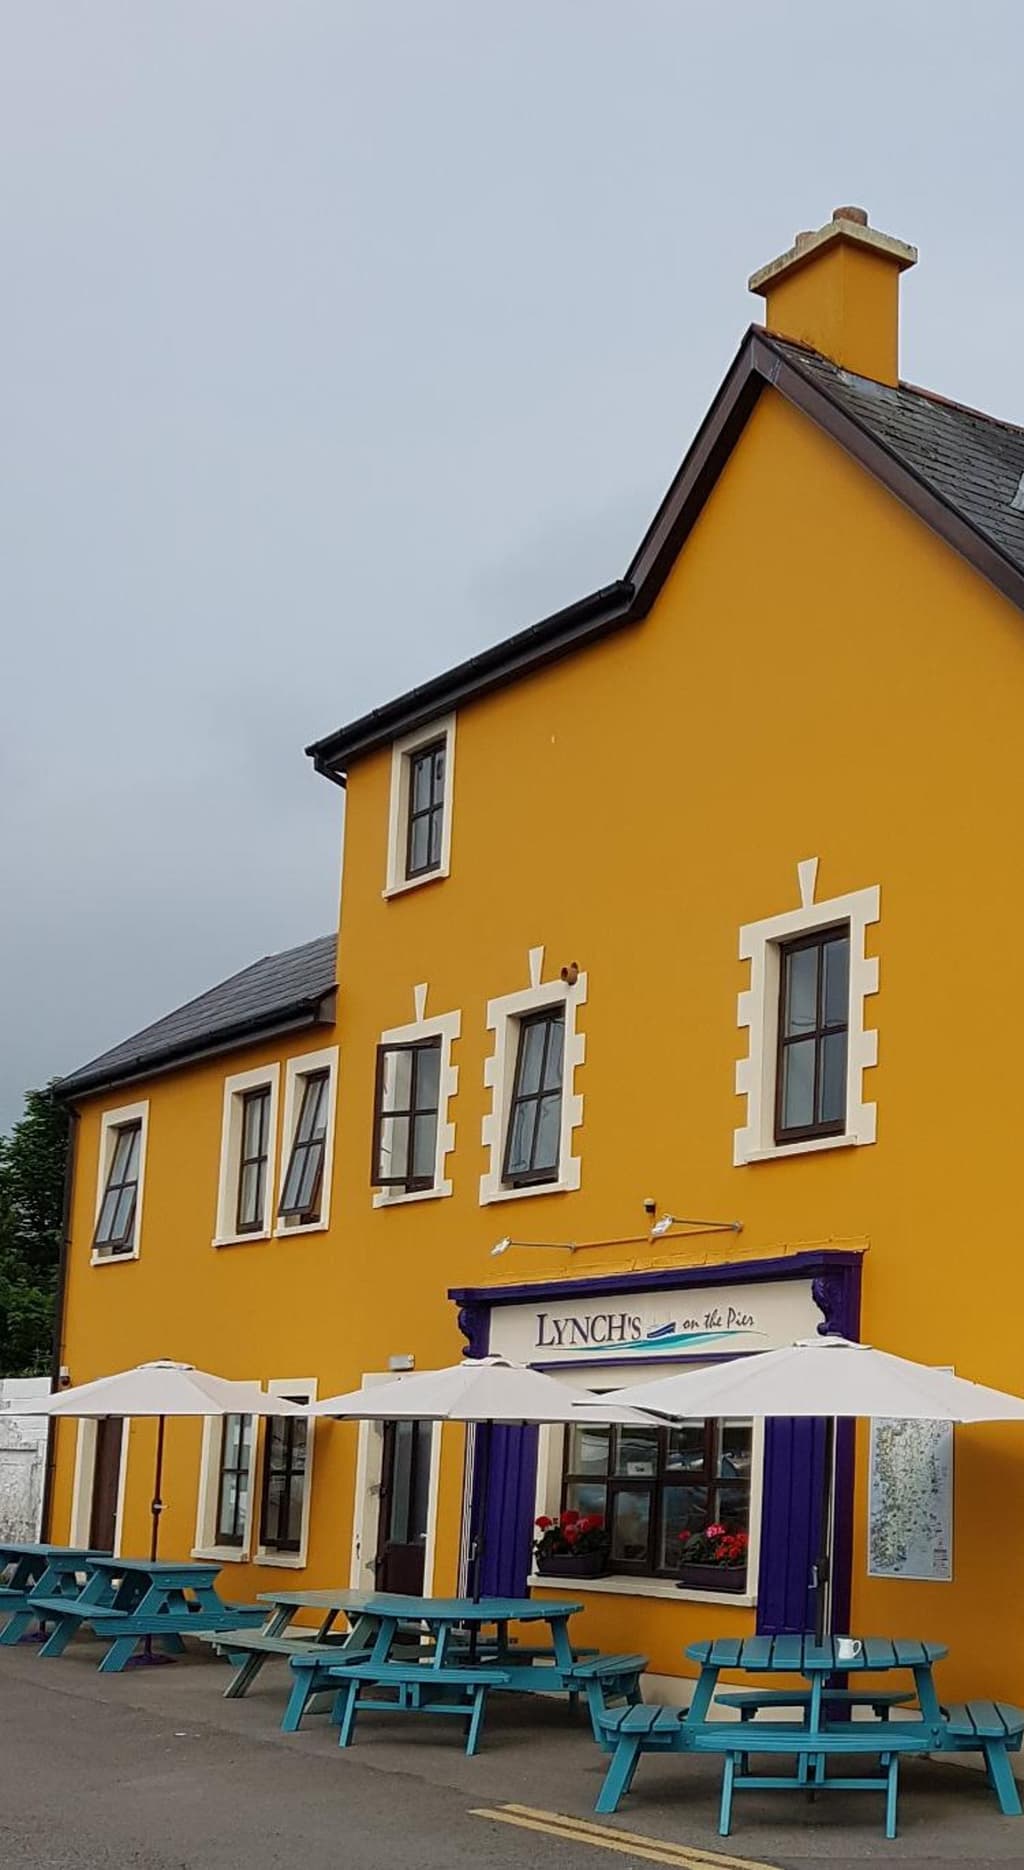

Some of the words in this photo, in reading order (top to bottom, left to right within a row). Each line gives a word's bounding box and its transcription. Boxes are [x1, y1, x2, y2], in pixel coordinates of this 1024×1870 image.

[535, 1313, 642, 1347] LYNCH'S
[682, 1319, 700, 1329] on
[704, 1308, 722, 1329] the
[727, 1307, 754, 1329] Pier
